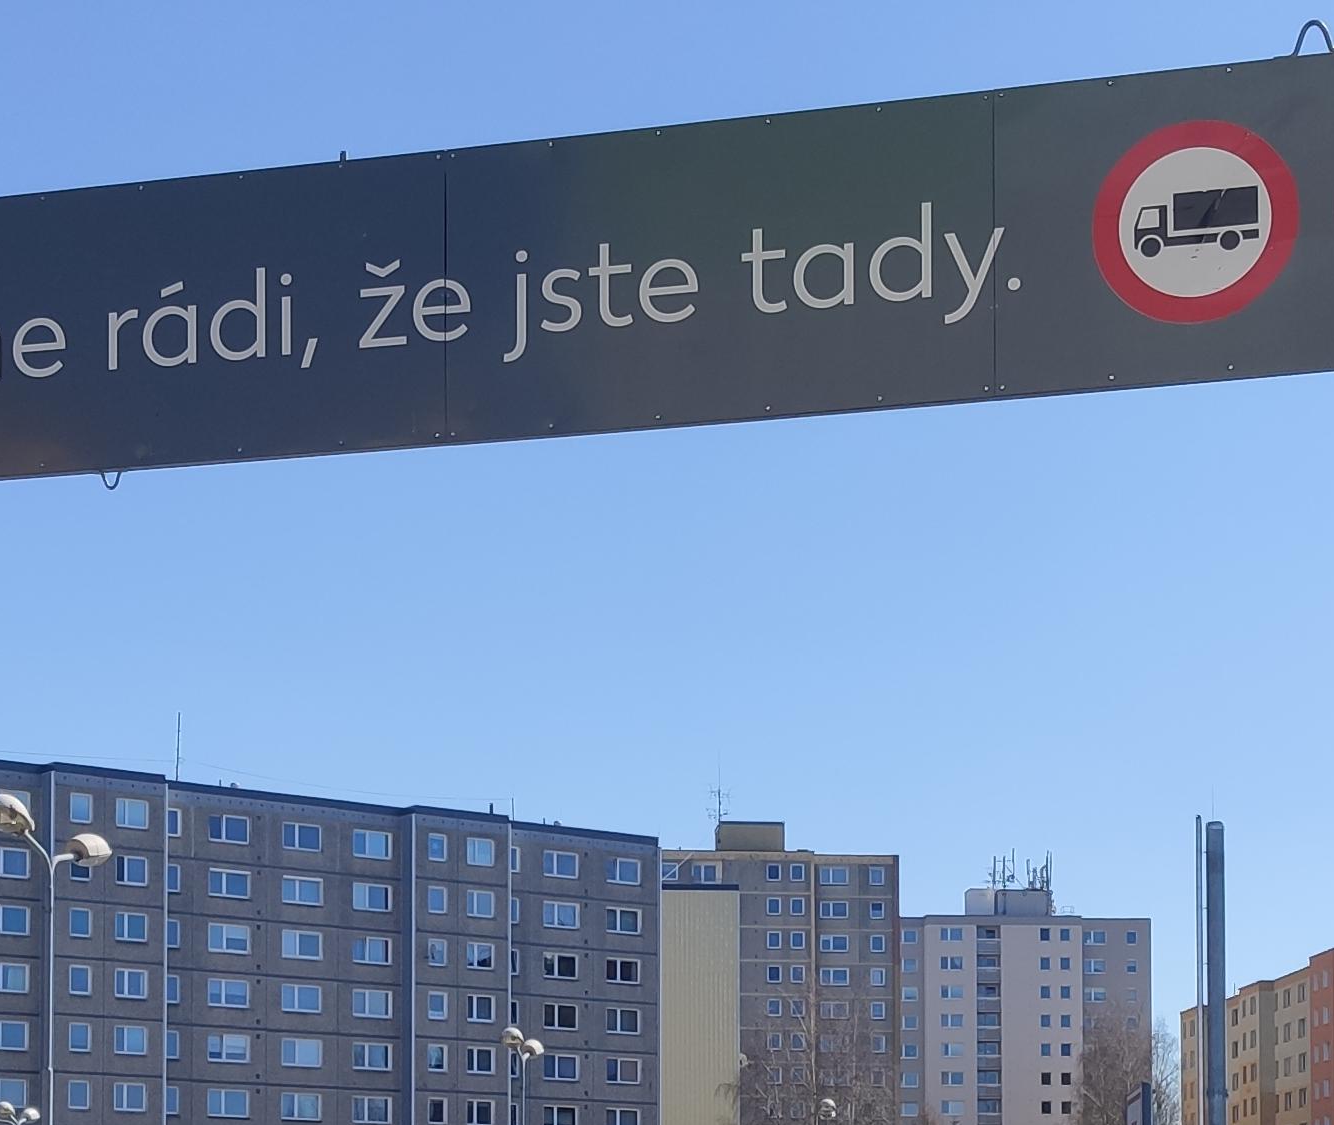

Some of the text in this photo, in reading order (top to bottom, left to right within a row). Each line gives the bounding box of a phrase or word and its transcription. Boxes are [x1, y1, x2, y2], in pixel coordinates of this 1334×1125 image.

[108, 267, 318, 371] rádi,
[359, 259, 471, 349] že
[503, 242, 699, 363] jste
[741, 201, 1021, 325] tady.
